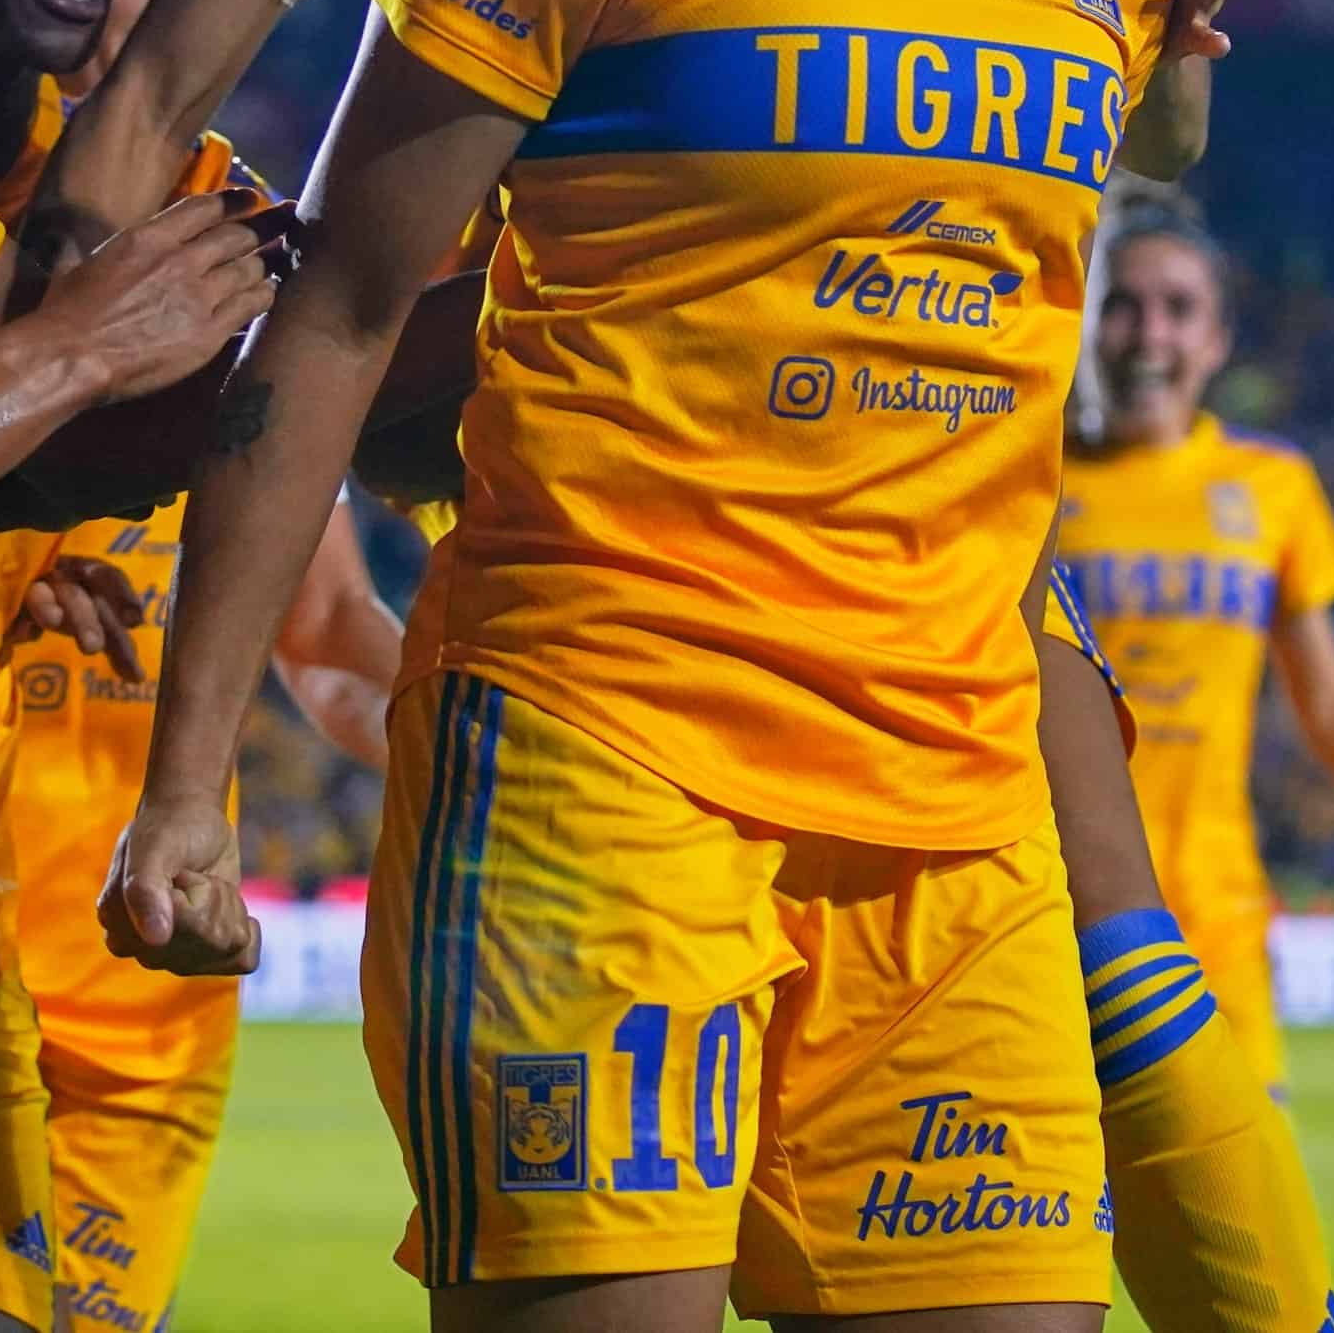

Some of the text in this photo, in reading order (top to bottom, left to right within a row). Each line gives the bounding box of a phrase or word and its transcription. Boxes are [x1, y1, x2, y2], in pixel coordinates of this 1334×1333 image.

[755, 33, 1125, 184] TIGRES
[814, 250, 994, 328] Vertua
[851, 368, 1017, 433] Instagram
[505, 1064, 579, 1085] TIGRES
[900, 1091, 1008, 1162] Tim
[517, 1164, 562, 1180] UANL
[857, 1170, 1070, 1241] Hortons
[64, 1202, 137, 1270] Tim
